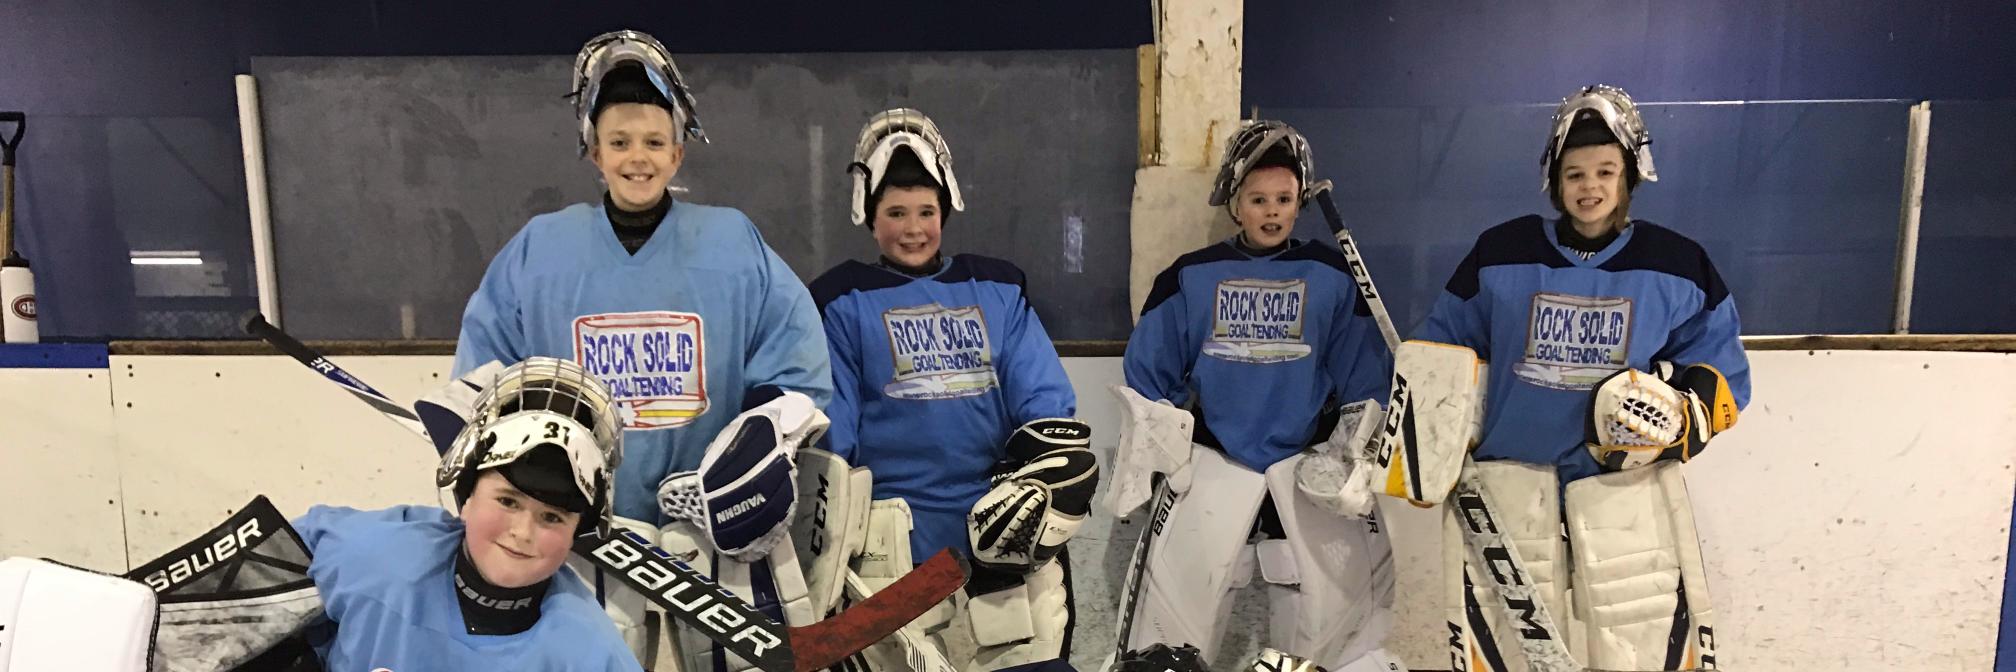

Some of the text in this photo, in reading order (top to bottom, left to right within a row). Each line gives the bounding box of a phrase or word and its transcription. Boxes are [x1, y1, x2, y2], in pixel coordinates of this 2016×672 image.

[1340, 239, 1377, 298] CCM
[1220, 289, 1299, 322] ROCK SOLID
[1578, 311, 1624, 345] SOLID
[583, 331, 693, 375] ROCK SOLID
[890, 316, 984, 355] ROCK SOLID
[543, 421, 571, 446] 31
[1042, 427, 1079, 436] CCM
[1377, 373, 1408, 469] CCM
[715, 493, 767, 524] VAUGHN
[811, 473, 829, 556] CCM
[1153, 488, 1179, 537] BAU
[1459, 492, 1552, 640] CCM
[591, 539, 782, 658] BAUER
[1447, 620, 1467, 672] CM
[1698, 624, 1716, 669] CC
